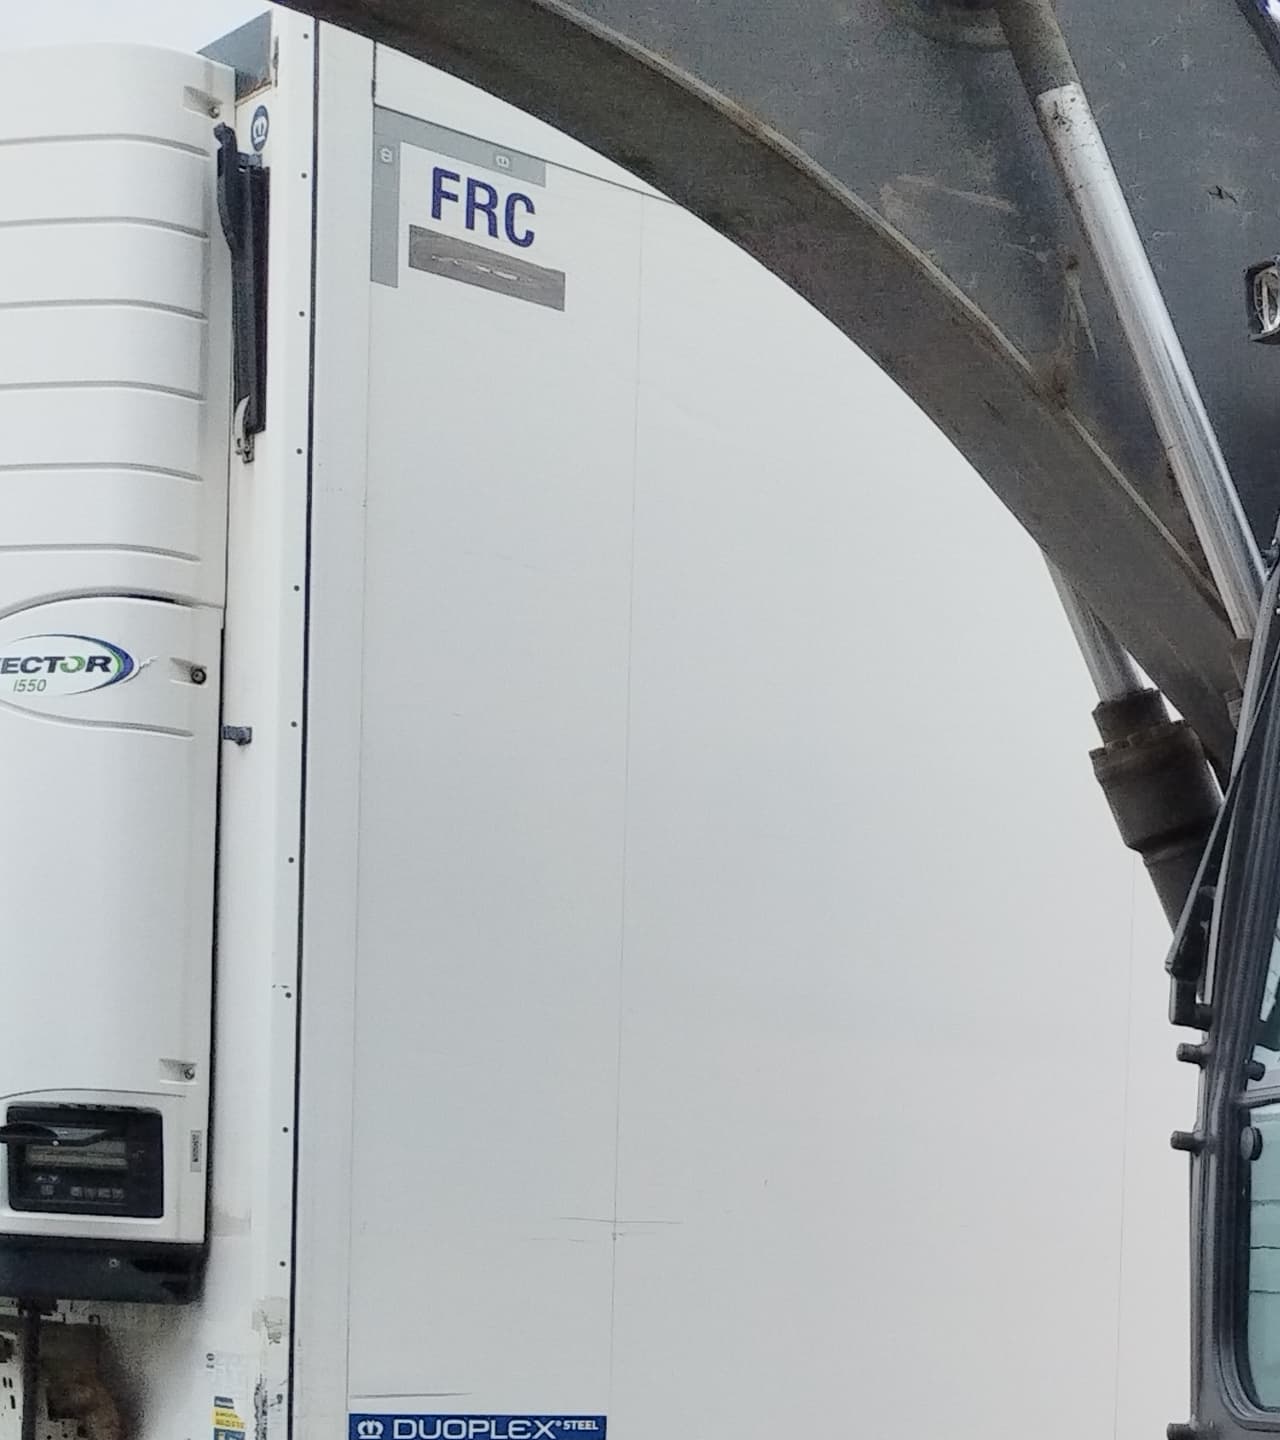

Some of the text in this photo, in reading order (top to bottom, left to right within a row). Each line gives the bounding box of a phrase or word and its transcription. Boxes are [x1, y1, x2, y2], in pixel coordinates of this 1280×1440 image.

[431, 166, 536, 248] FRC
[0, 656, 112, 674] ECTOR
[563, 1420, 599, 1430] STEEL
